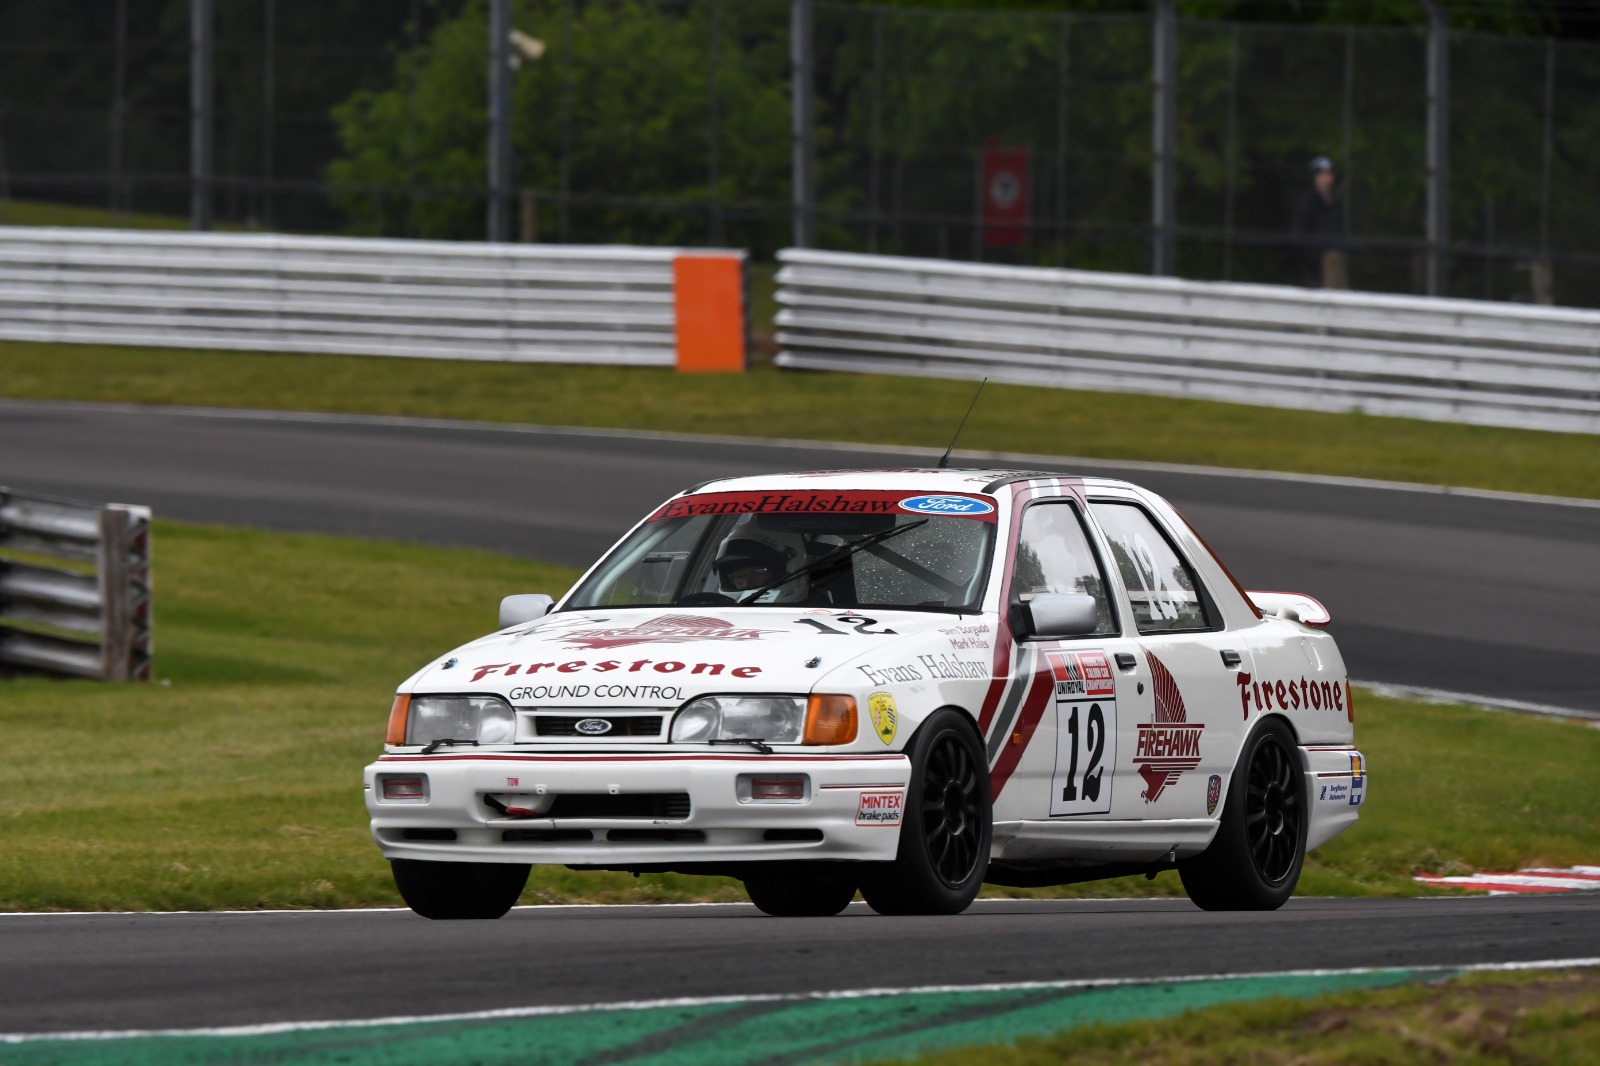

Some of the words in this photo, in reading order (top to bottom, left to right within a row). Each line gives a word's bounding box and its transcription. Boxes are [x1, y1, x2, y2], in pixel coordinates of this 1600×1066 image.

[918, 498, 974, 511] Ford
[793, 616, 899, 635] 12
[949, 638, 971, 650] Mark
[968, 637, 990, 649] Hales
[469, 659, 763, 683] Firestone
[856, 664, 923, 687] Evans
[916, 653, 990, 679] Halshaw
[509, 686, 590, 700] GROUND
[594, 685, 686, 700] CONTROL
[1057, 681, 1085, 695] UNIROYAL
[1237, 672, 1343, 721] Firestone
[1136, 730, 1203, 757] FIREHAWK
[1062, 703, 1105, 803] 12
[861, 795, 901, 809] MINTEX
[858, 810, 882, 821] brake
[881, 810, 900, 823] pads
